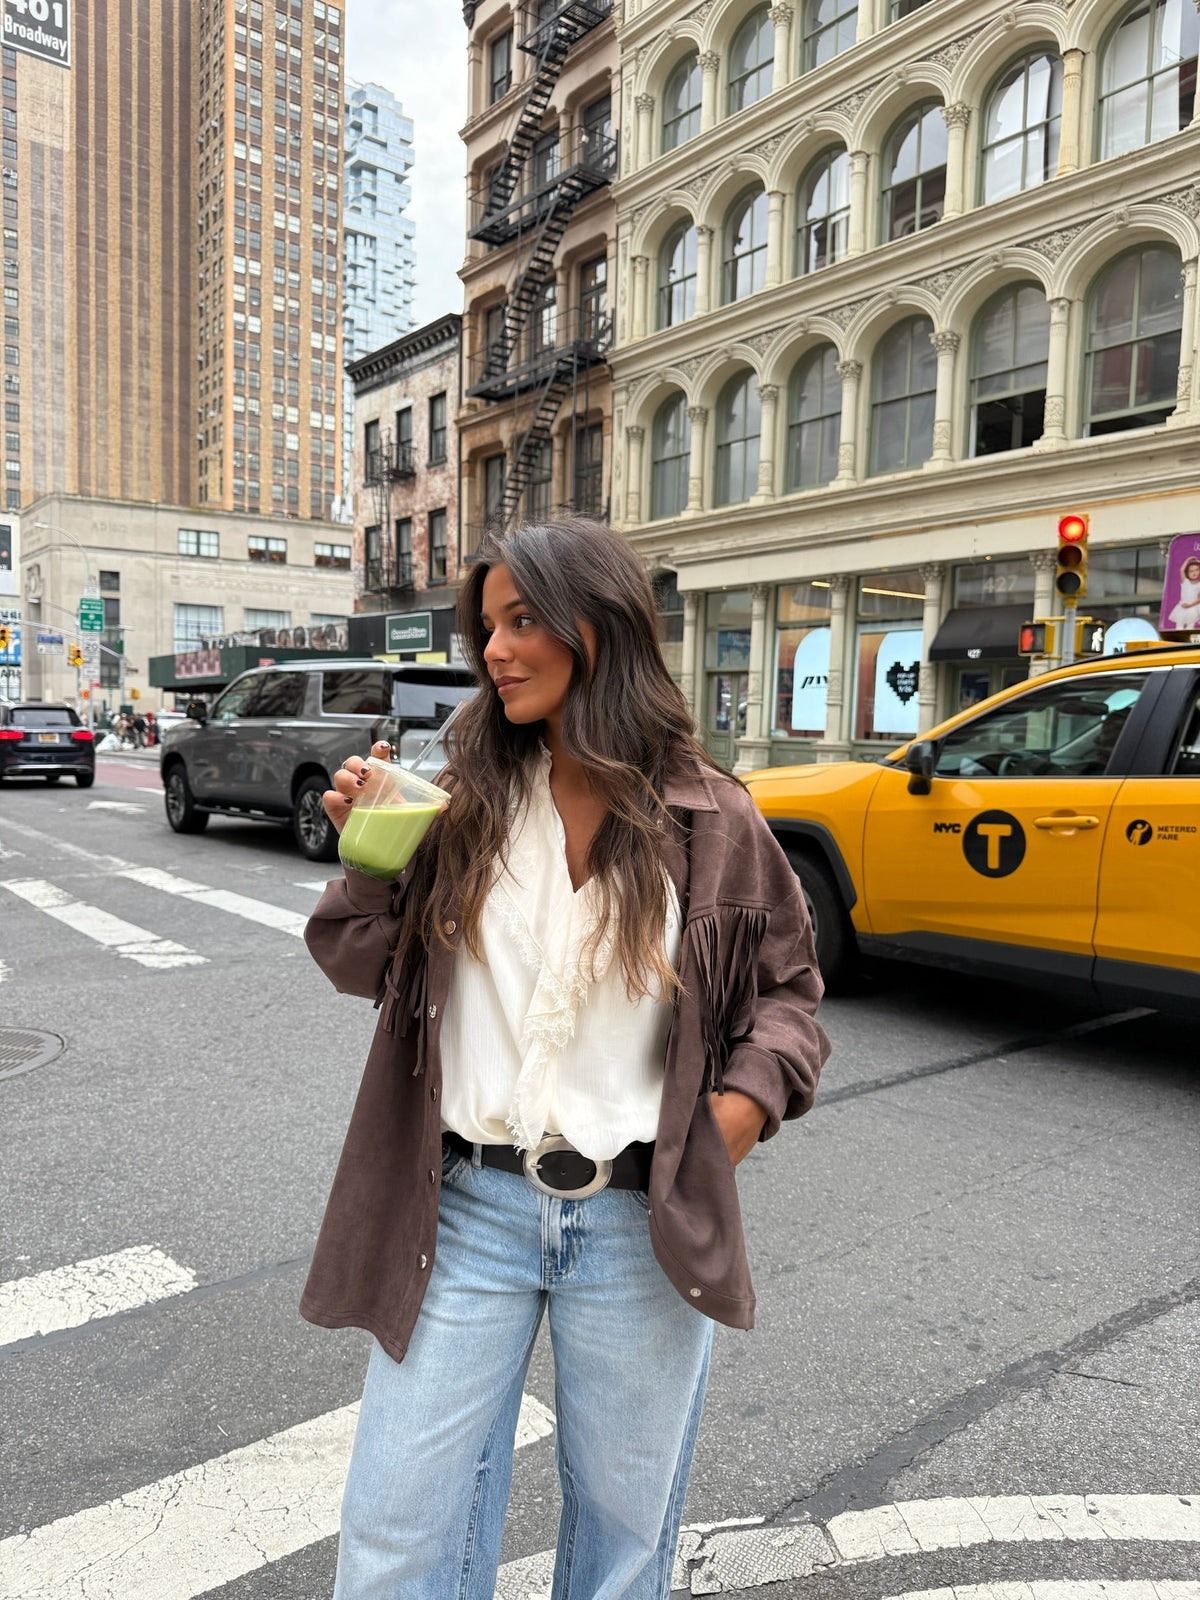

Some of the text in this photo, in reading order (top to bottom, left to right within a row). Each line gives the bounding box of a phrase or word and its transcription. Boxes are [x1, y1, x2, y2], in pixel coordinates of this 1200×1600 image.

[4, 13, 67, 57] Broadway
[983, 575, 1018, 594] 427
[934, 822, 961, 833] NYC
[977, 823, 1012, 869] T
